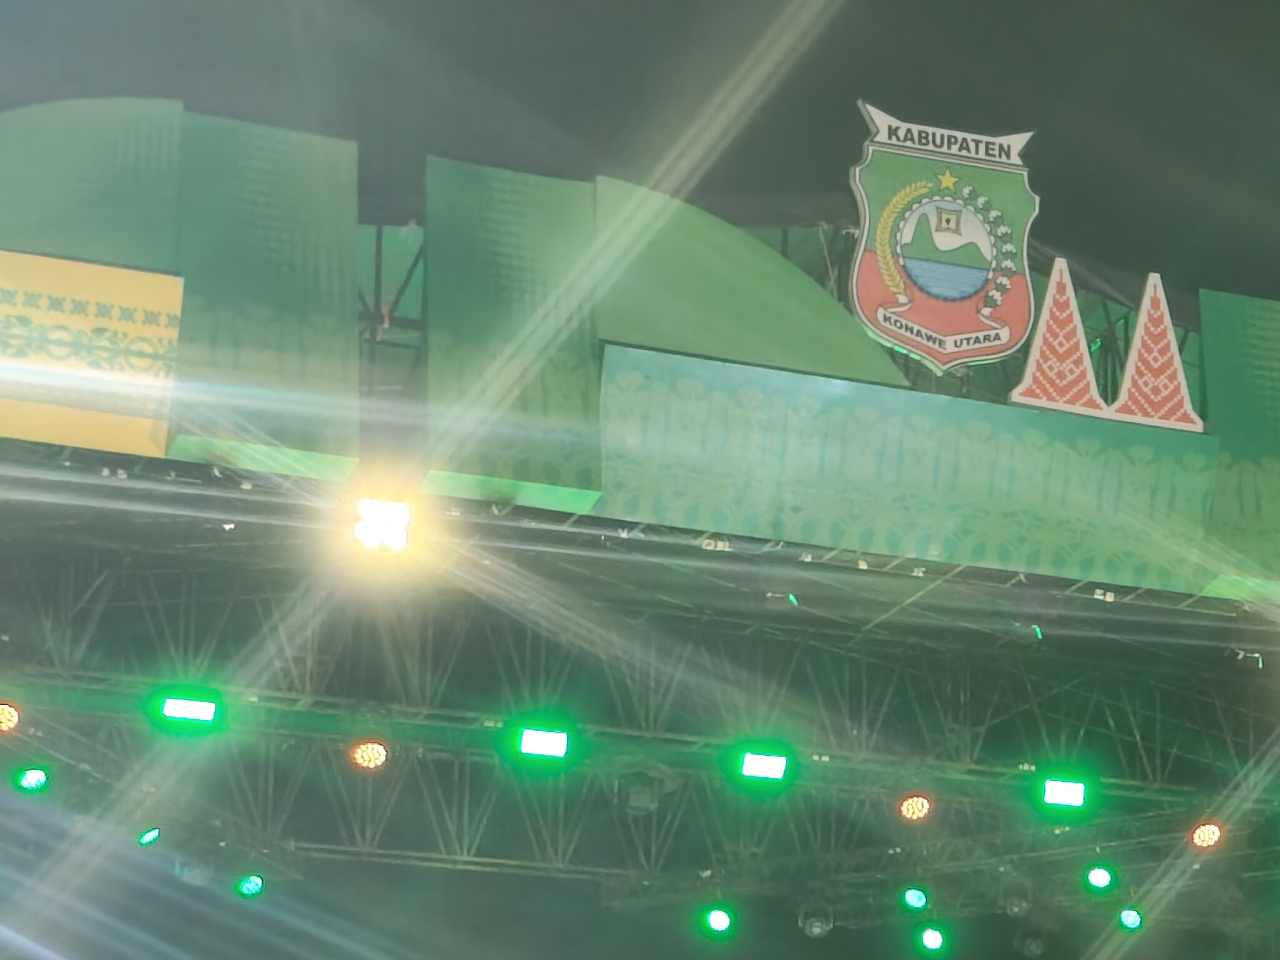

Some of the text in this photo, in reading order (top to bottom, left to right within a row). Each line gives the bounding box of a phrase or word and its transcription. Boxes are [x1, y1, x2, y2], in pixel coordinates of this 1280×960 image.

[887, 124, 1012, 161] KABUPATEN
[882, 312, 1002, 349] KONAWE UTARA
